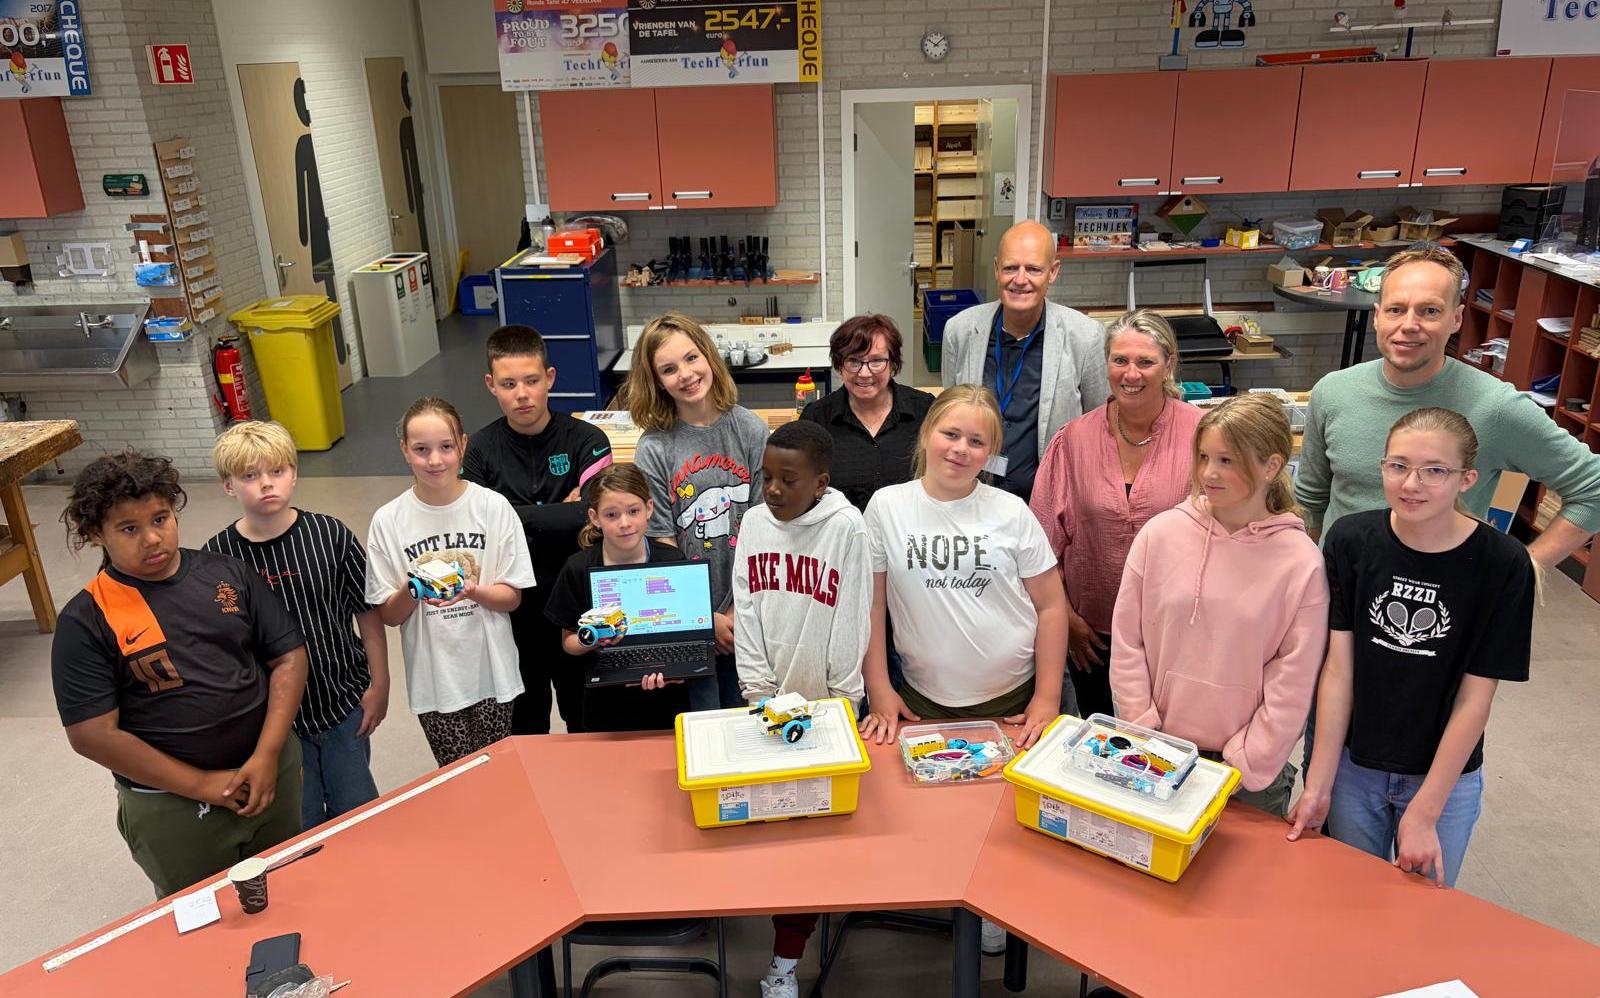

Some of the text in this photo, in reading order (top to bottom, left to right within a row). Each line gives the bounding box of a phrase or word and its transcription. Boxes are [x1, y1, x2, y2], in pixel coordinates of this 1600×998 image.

[30, 4, 52, 13] 2017
[502, 18, 550, 33] PROUD
[632, 20, 696, 31] VRIENDEN VAN
[704, 8, 791, 31] 2547,-
[639, 29, 679, 38] DE TAFEL
[60, 1, 88, 90] CHEQUE
[510, 37, 546, 48] FOUT
[681, 55, 769, 69] Techfrfun
[1078, 222, 1128, 232] TECHNIEK
[404, 532, 487, 562] NOT LAZY
[925, 571, 992, 598] not today
[1391, 581, 1437, 604] RZZD
[128, 648, 184, 693] 10
